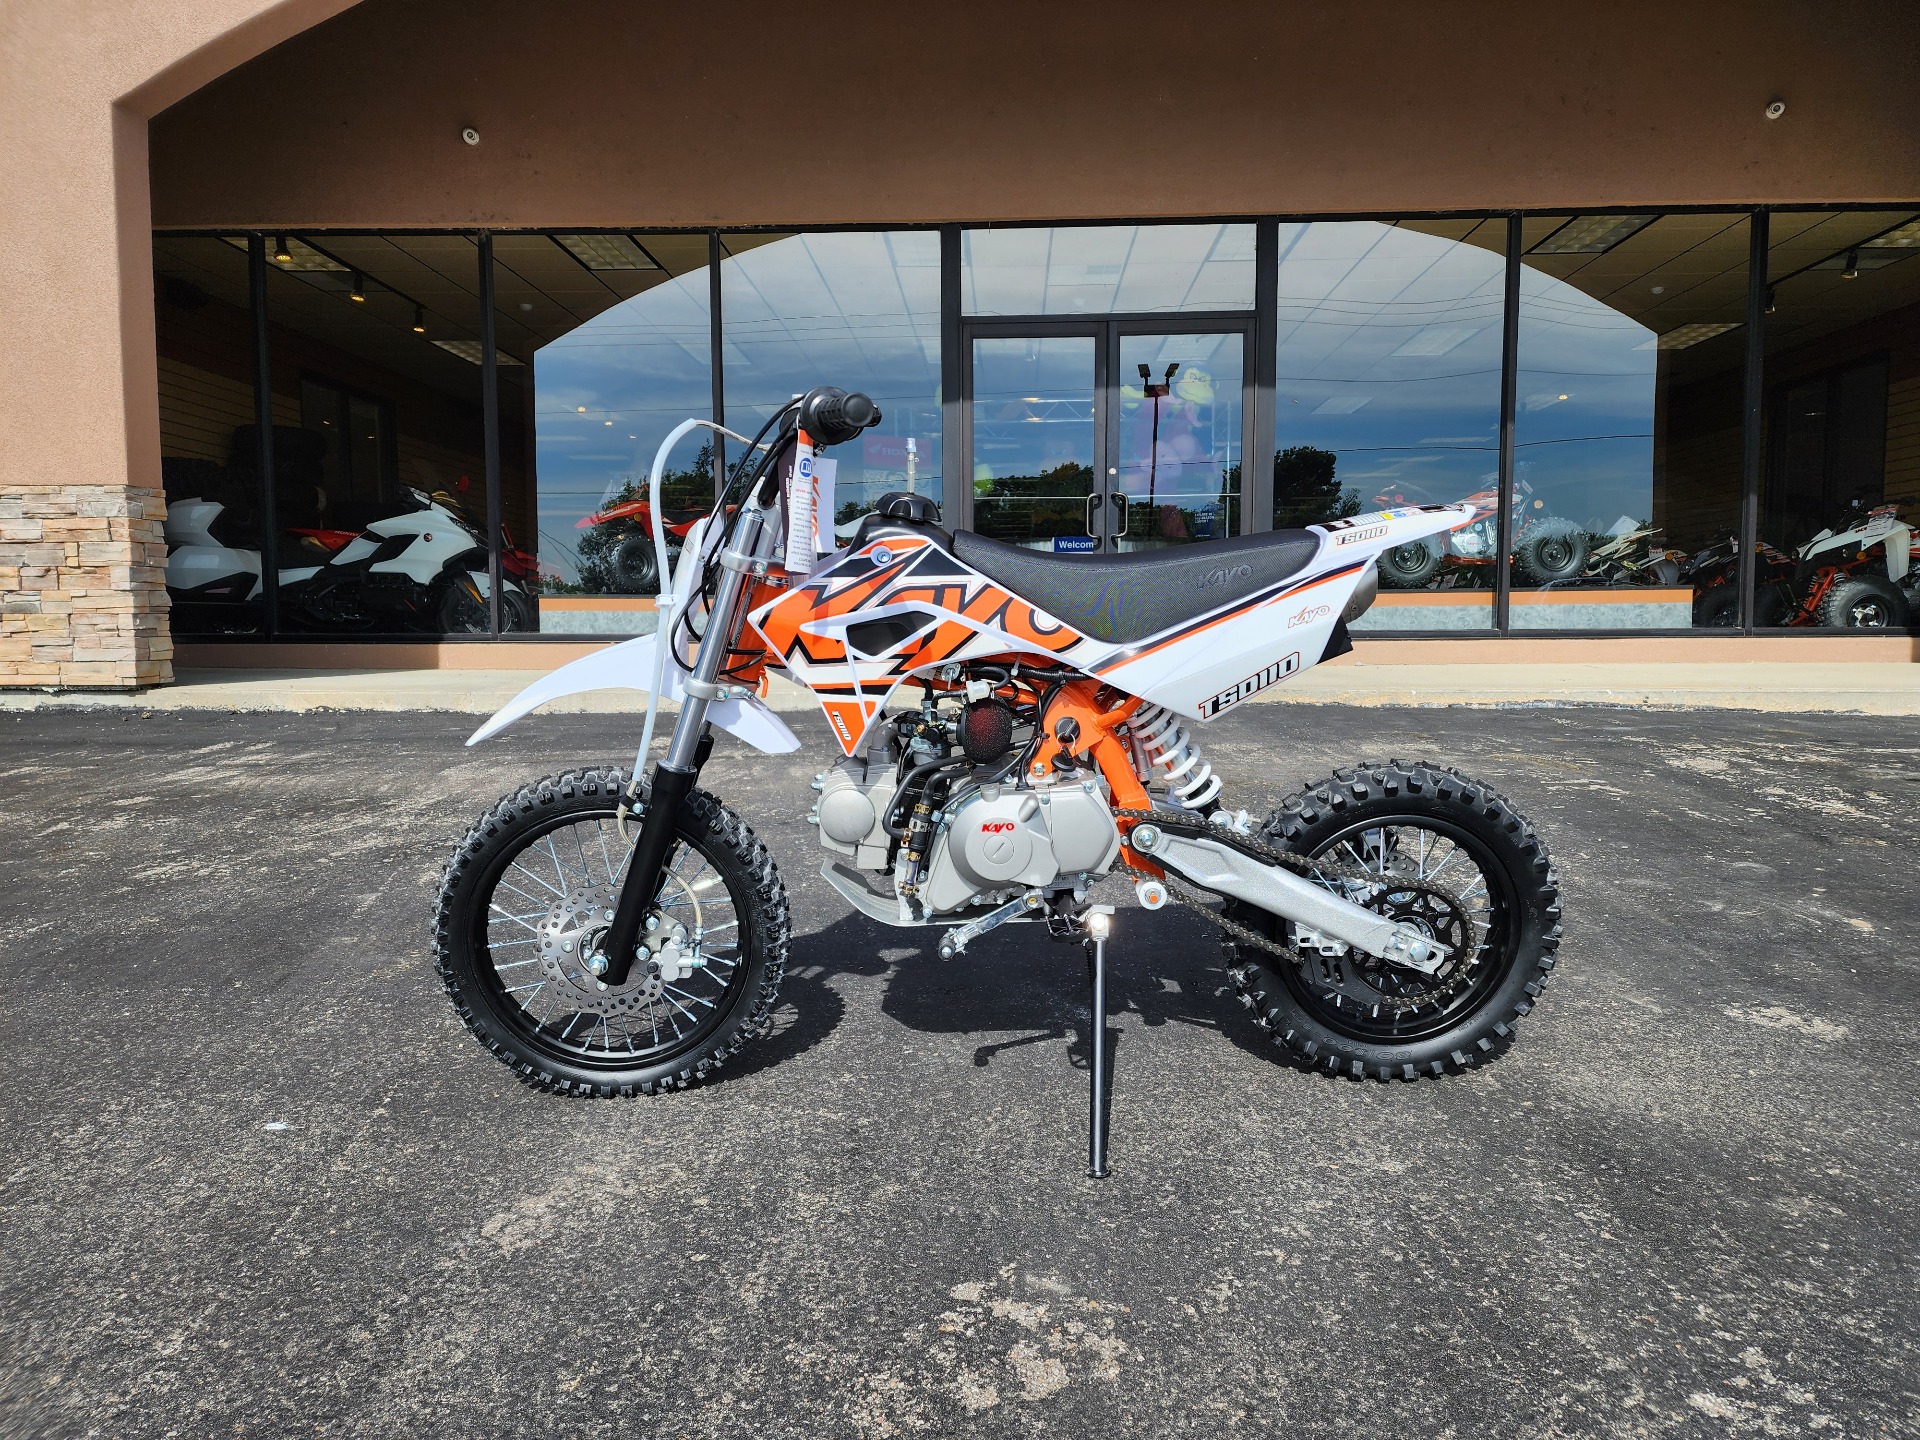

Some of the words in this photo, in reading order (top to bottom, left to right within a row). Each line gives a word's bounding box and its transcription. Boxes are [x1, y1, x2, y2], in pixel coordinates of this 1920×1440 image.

[1058, 540, 1094, 549] Welcom
[1197, 564, 1254, 590] KAYO
[1287, 605, 1331, 630] KAYO
[981, 821, 1015, 834] KAYO
